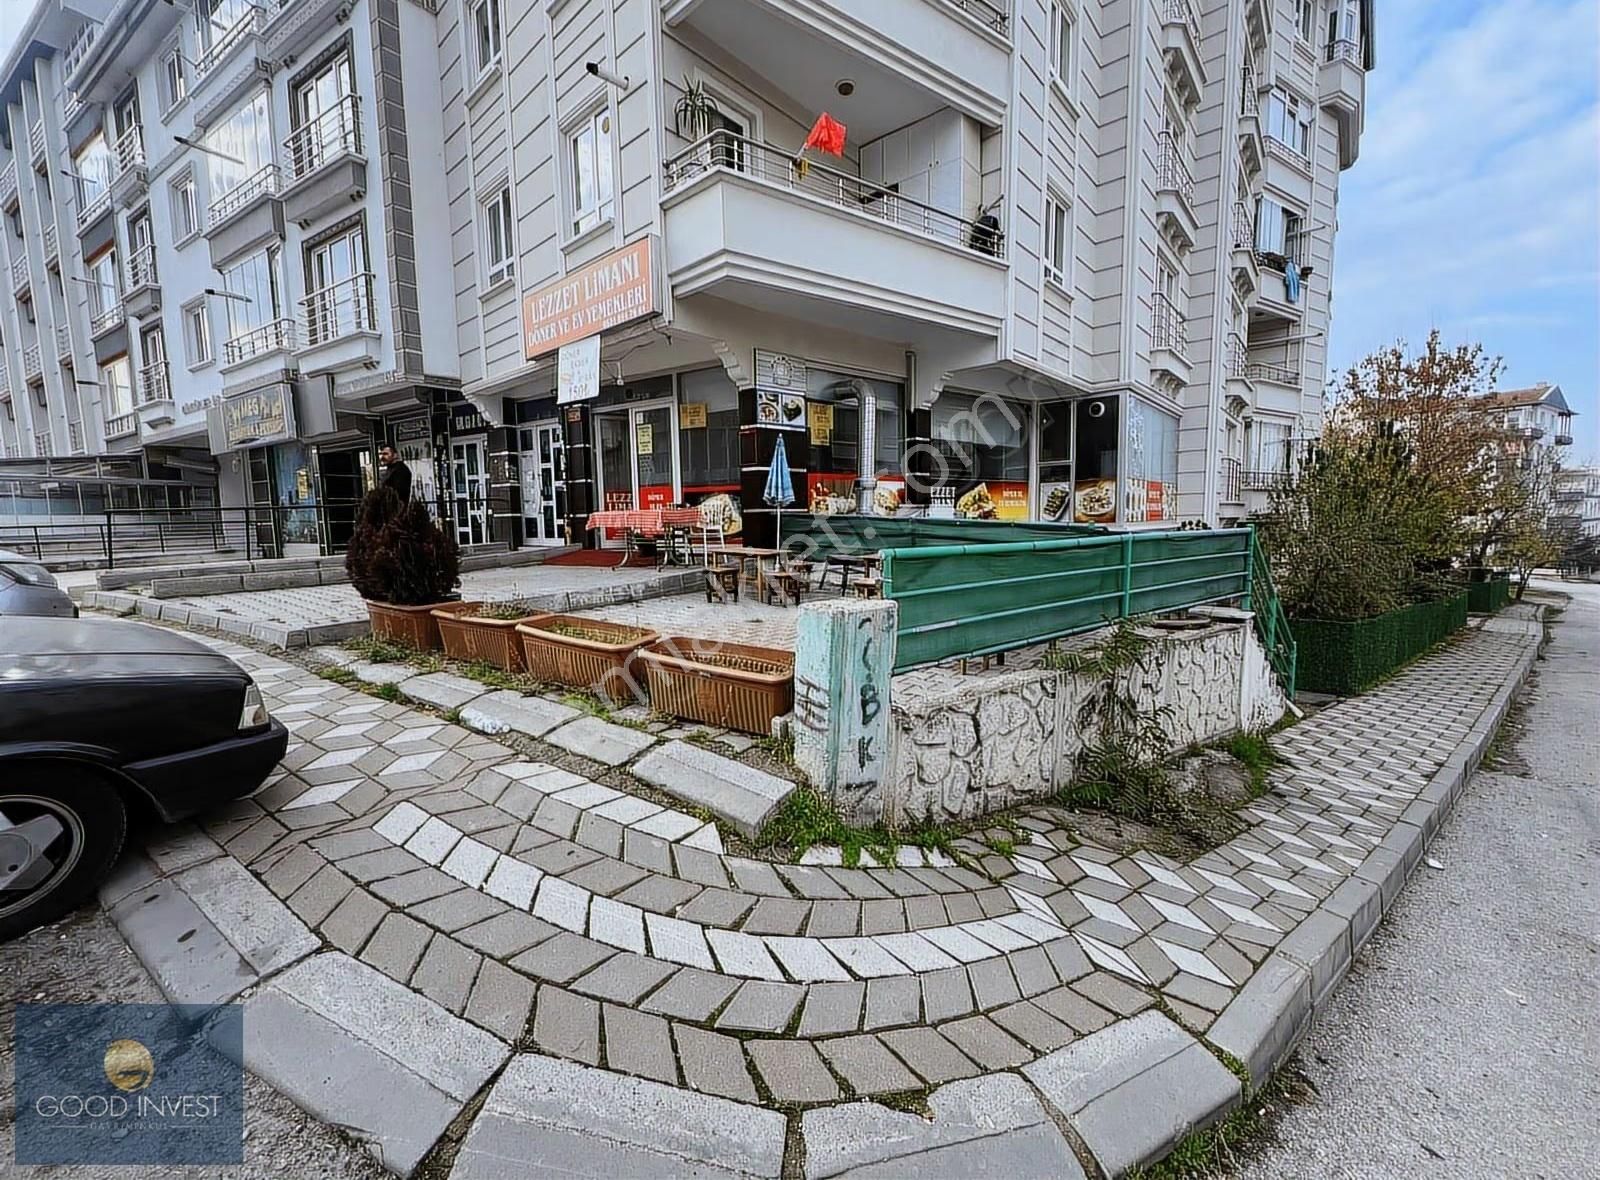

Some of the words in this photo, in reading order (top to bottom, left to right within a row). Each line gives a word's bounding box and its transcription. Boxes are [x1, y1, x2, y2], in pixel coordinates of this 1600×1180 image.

[531, 280, 580, 323] LEZZET
[558, 316, 569, 337] VE
[572, 309, 584, 330] EV
